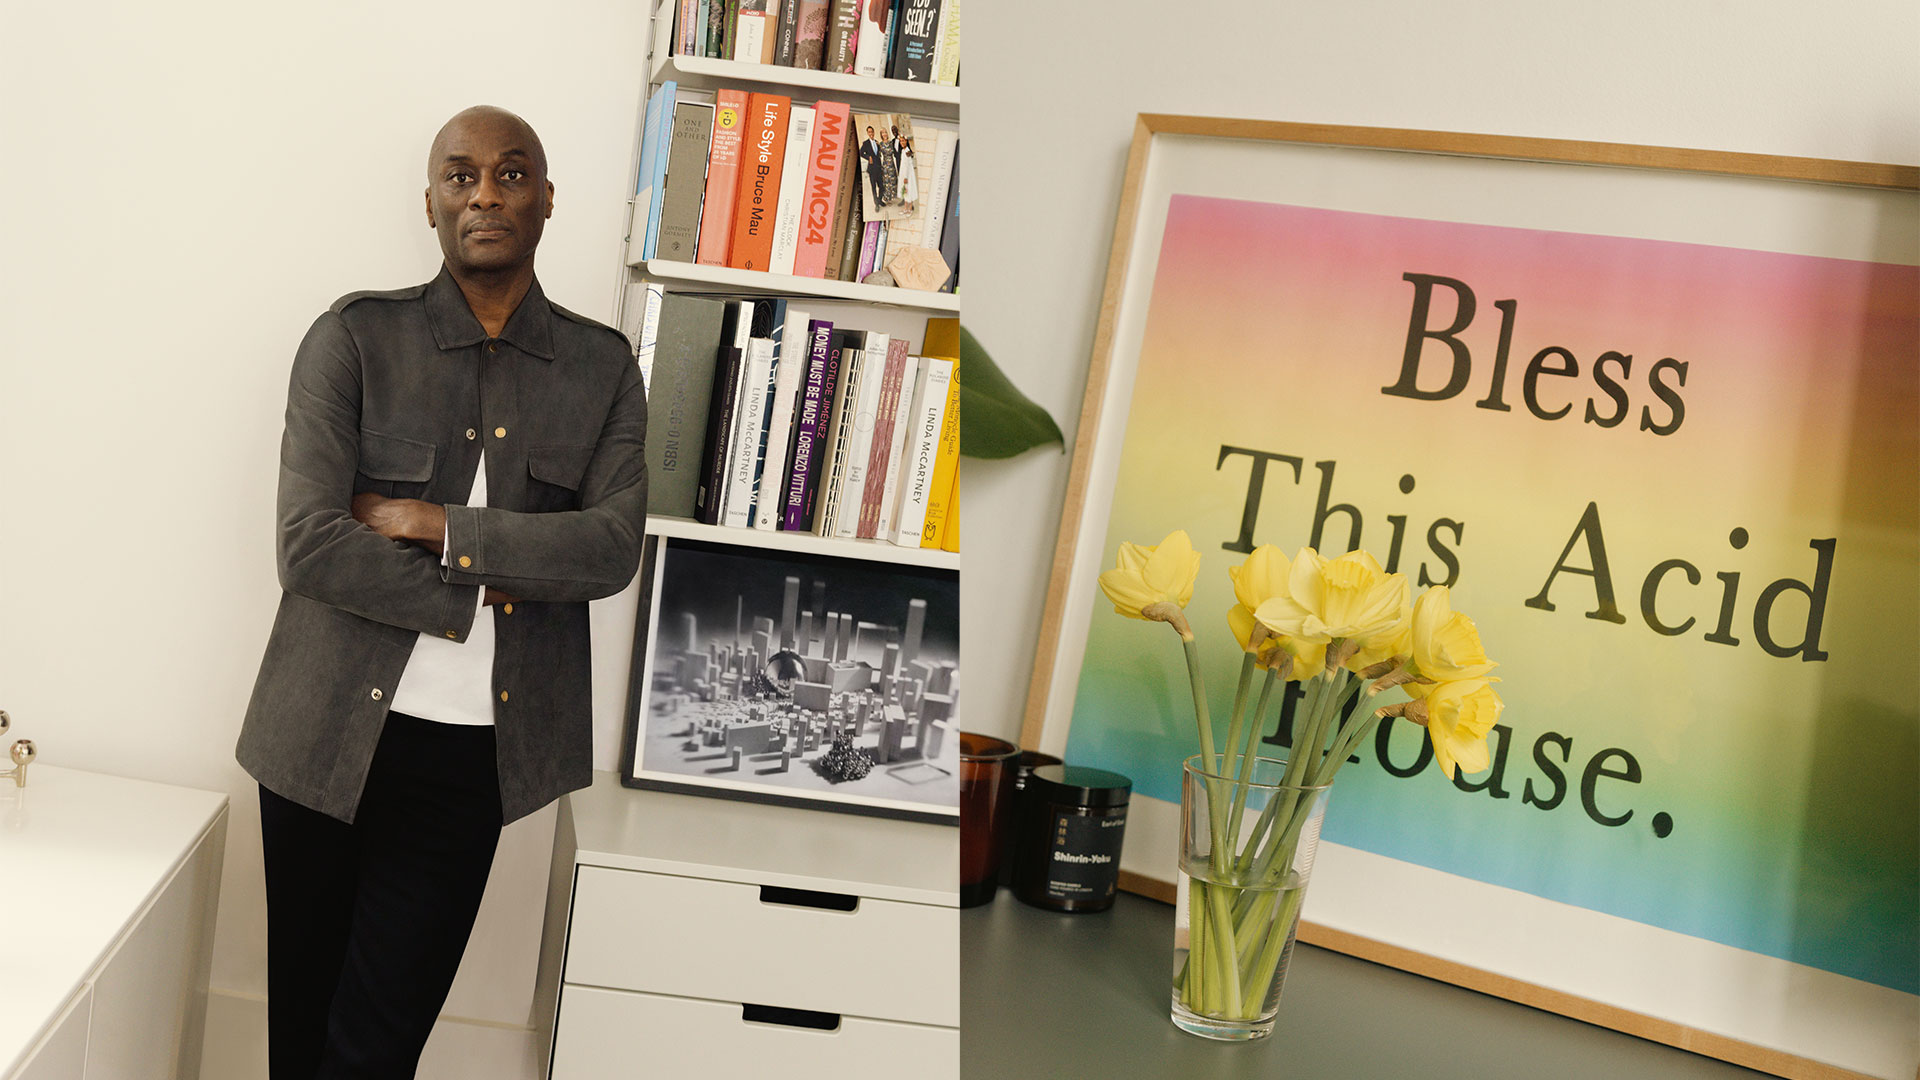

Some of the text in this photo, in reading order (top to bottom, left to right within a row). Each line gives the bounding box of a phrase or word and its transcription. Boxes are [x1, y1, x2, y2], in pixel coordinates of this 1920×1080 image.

[783, 29, 791, 58] CONNELL
[838, 39, 847, 62] BEAUTY
[676, 132, 707, 141] OTHER
[684, 119, 702, 128] ONE
[816, 112, 842, 171] MAU
[748, 102, 779, 236] Life Style Bruce Mau
[805, 175, 833, 245] MC24
[813, 326, 830, 360] MONEY
[1380, 272, 1689, 436] Bless
[809, 360, 825, 386] MUST
[806, 385, 820, 399] BE
[817, 349, 840, 439] CLOTILDE JIMÉNEZ
[802, 399, 818, 426] MADE
[949, 399, 958, 419] Better
[739, 387, 760, 484] LINDA McCARTNEY
[943, 420, 953, 442] Living
[947, 436, 957, 456] Guide
[663, 440, 680, 472] ISBN
[795, 431, 813, 472] LORENZO
[912, 407, 937, 504] LINDA McCARTNEY
[789, 473, 806, 507] VITTURI
[1216, 444, 1837, 662] This Acid
[1054, 851, 1112, 864] Shinrin-Yoku
